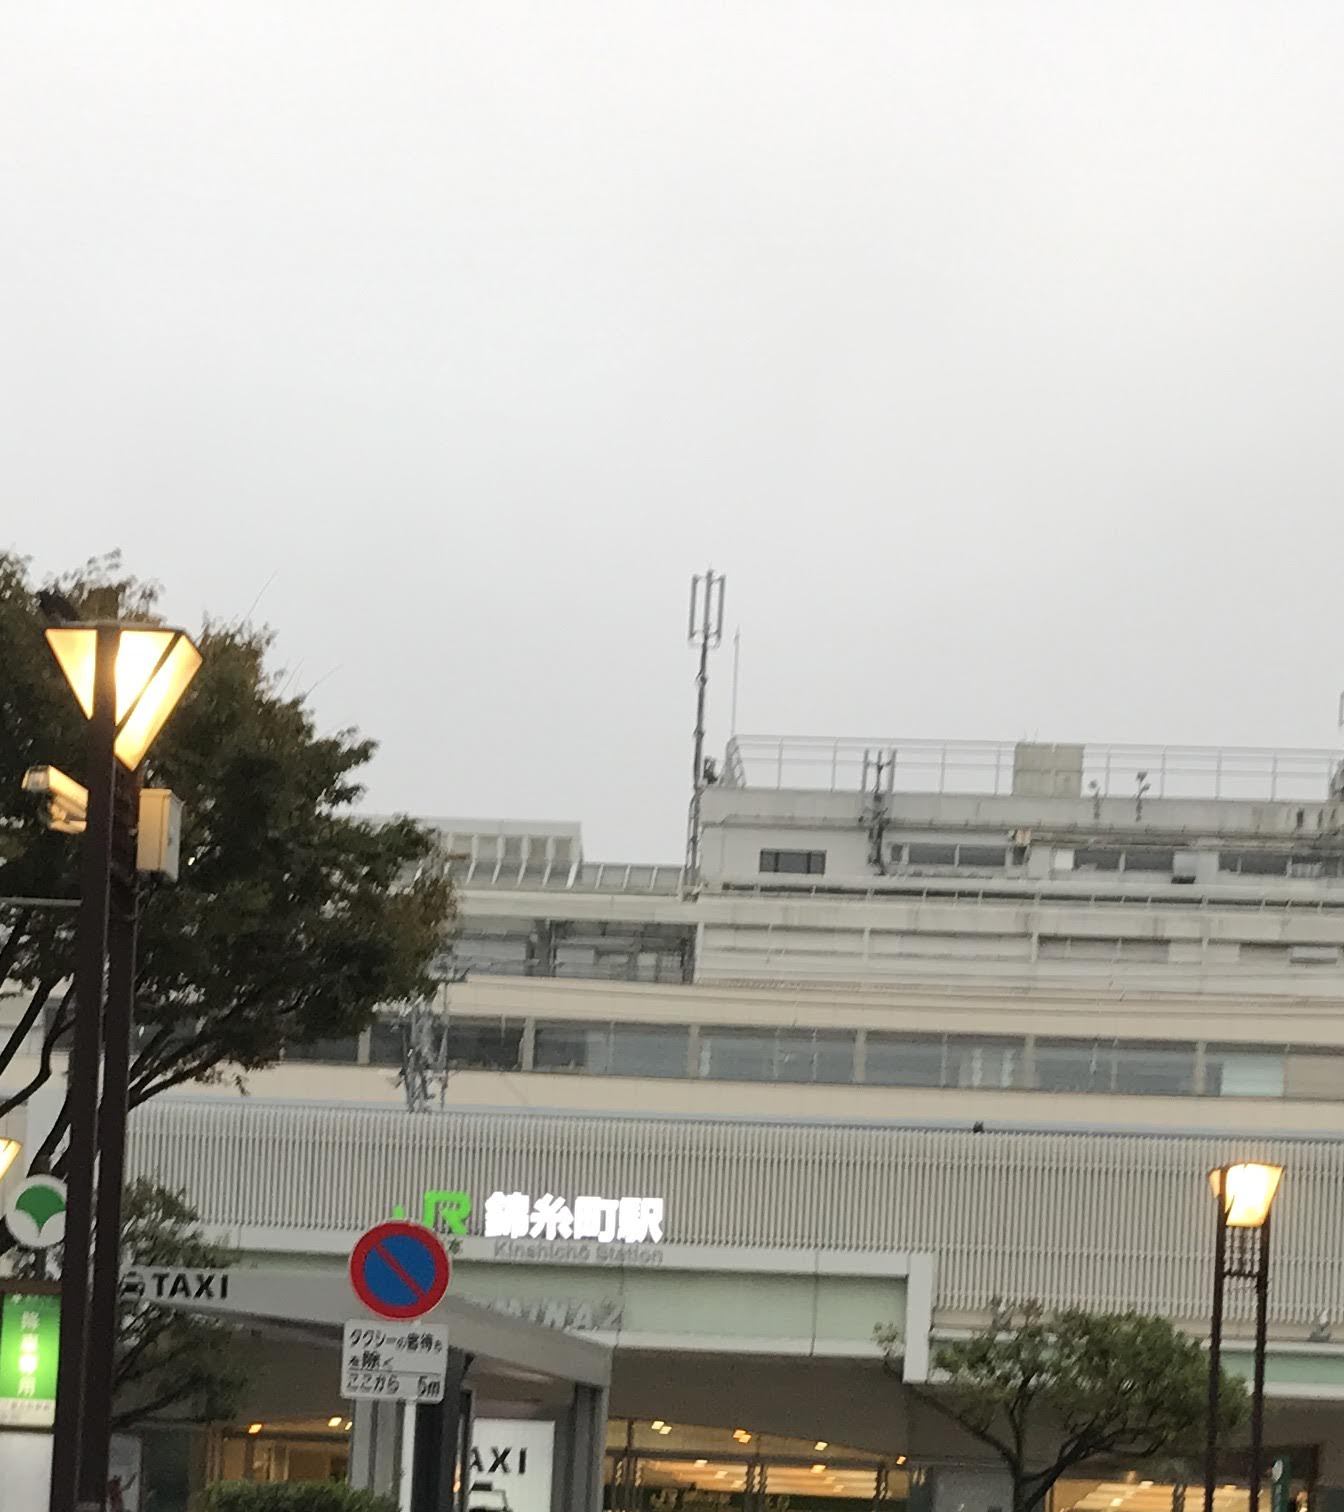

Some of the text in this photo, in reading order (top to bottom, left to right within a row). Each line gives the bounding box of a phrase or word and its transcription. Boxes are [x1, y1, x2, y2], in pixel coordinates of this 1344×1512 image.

[484, 1191, 664, 1244] 錦糸町駅
[151, 1272, 229, 1299] TAXI
[346, 1373, 441, 1397] ここから 5m
[470, 1446, 527, 1475] AXI
